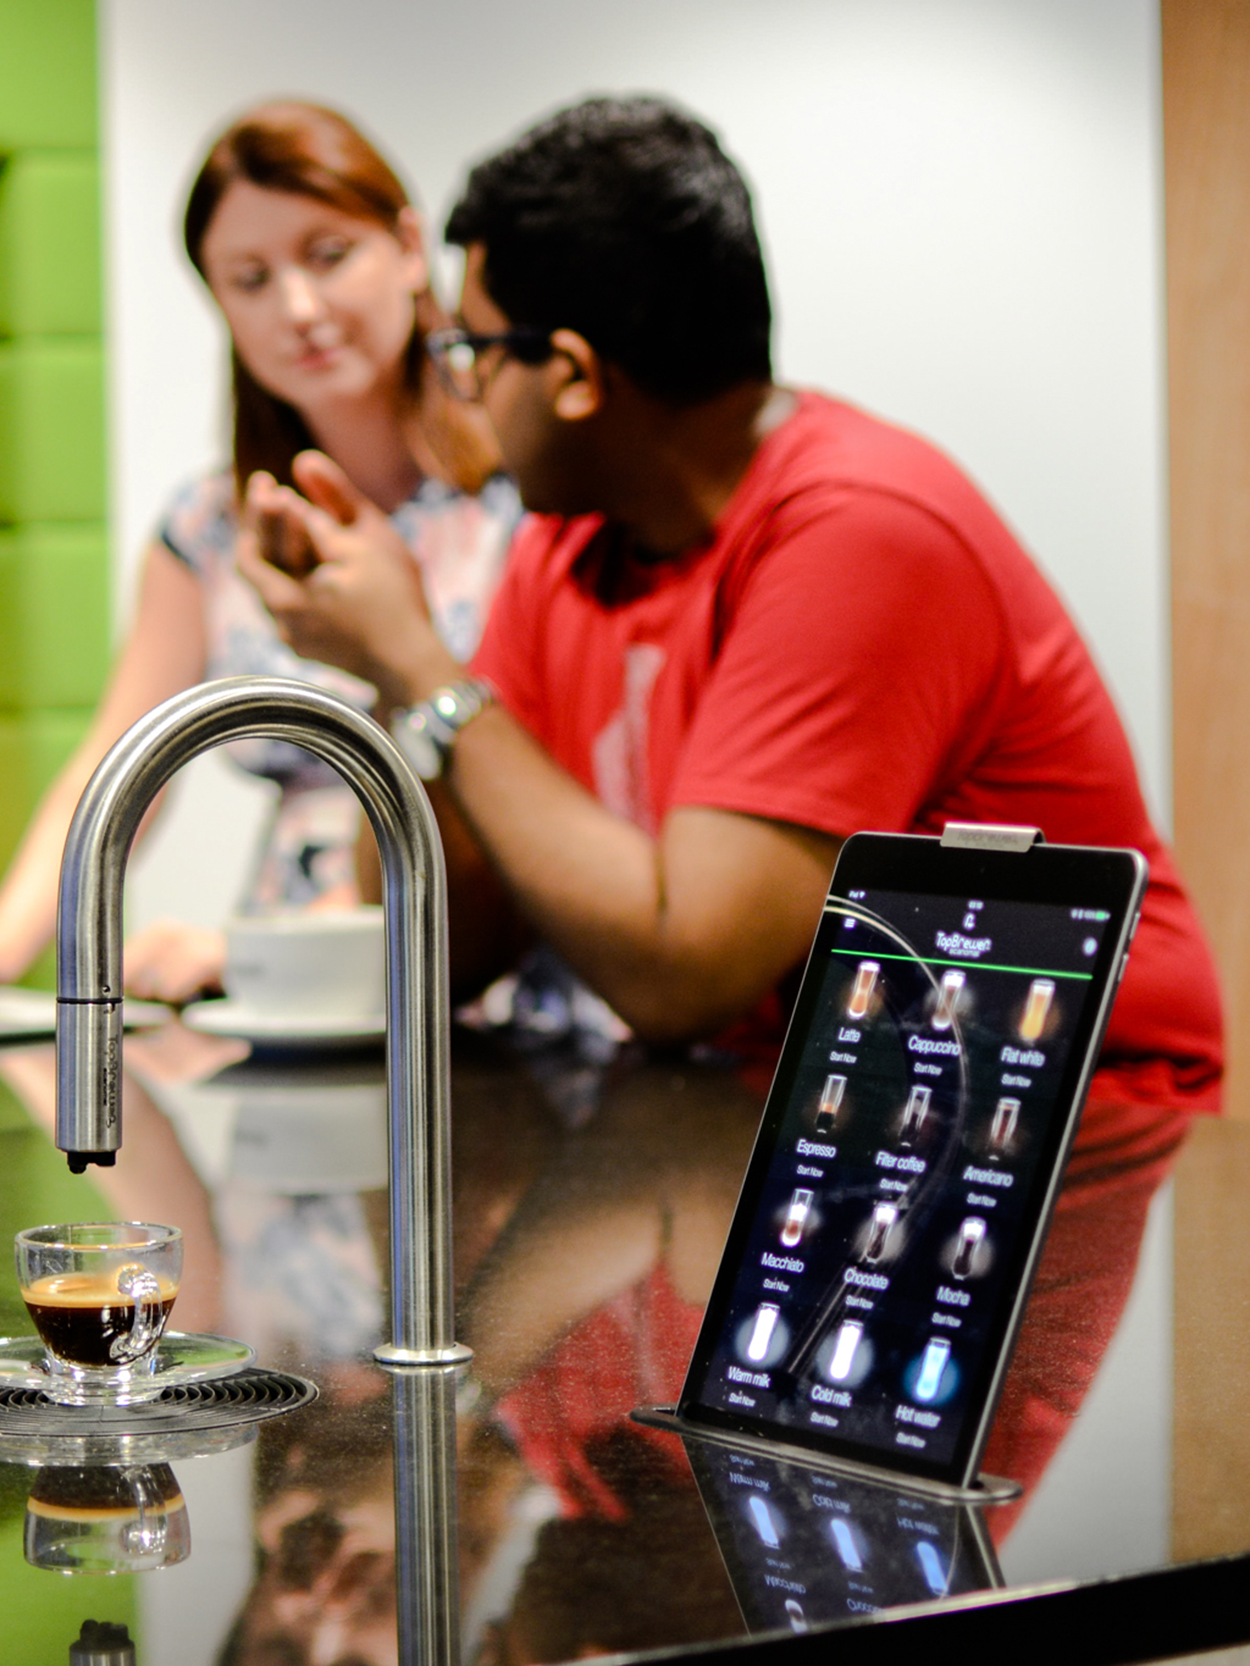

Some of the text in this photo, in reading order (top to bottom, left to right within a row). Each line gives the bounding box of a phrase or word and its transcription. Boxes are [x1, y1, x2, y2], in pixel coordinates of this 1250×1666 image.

[838, 1027, 861, 1042] Latte
[908, 1036, 961, 1056] Cappuccino
[1001, 1047, 1045, 1067] Flat white
[796, 1139, 836, 1158] Espresso
[876, 1151, 926, 1173] Filter coffee
[963, 1166, 1014, 1187] Americano
[761, 1253, 805, 1274] Macchiato
[844, 1268, 889, 1290] Chocolate
[937, 1286, 971, 1306] Mocha
[728, 1366, 771, 1388] Warm milk
[811, 1384, 851, 1408] Cold milk
[895, 1405, 941, 1429] Hot water
